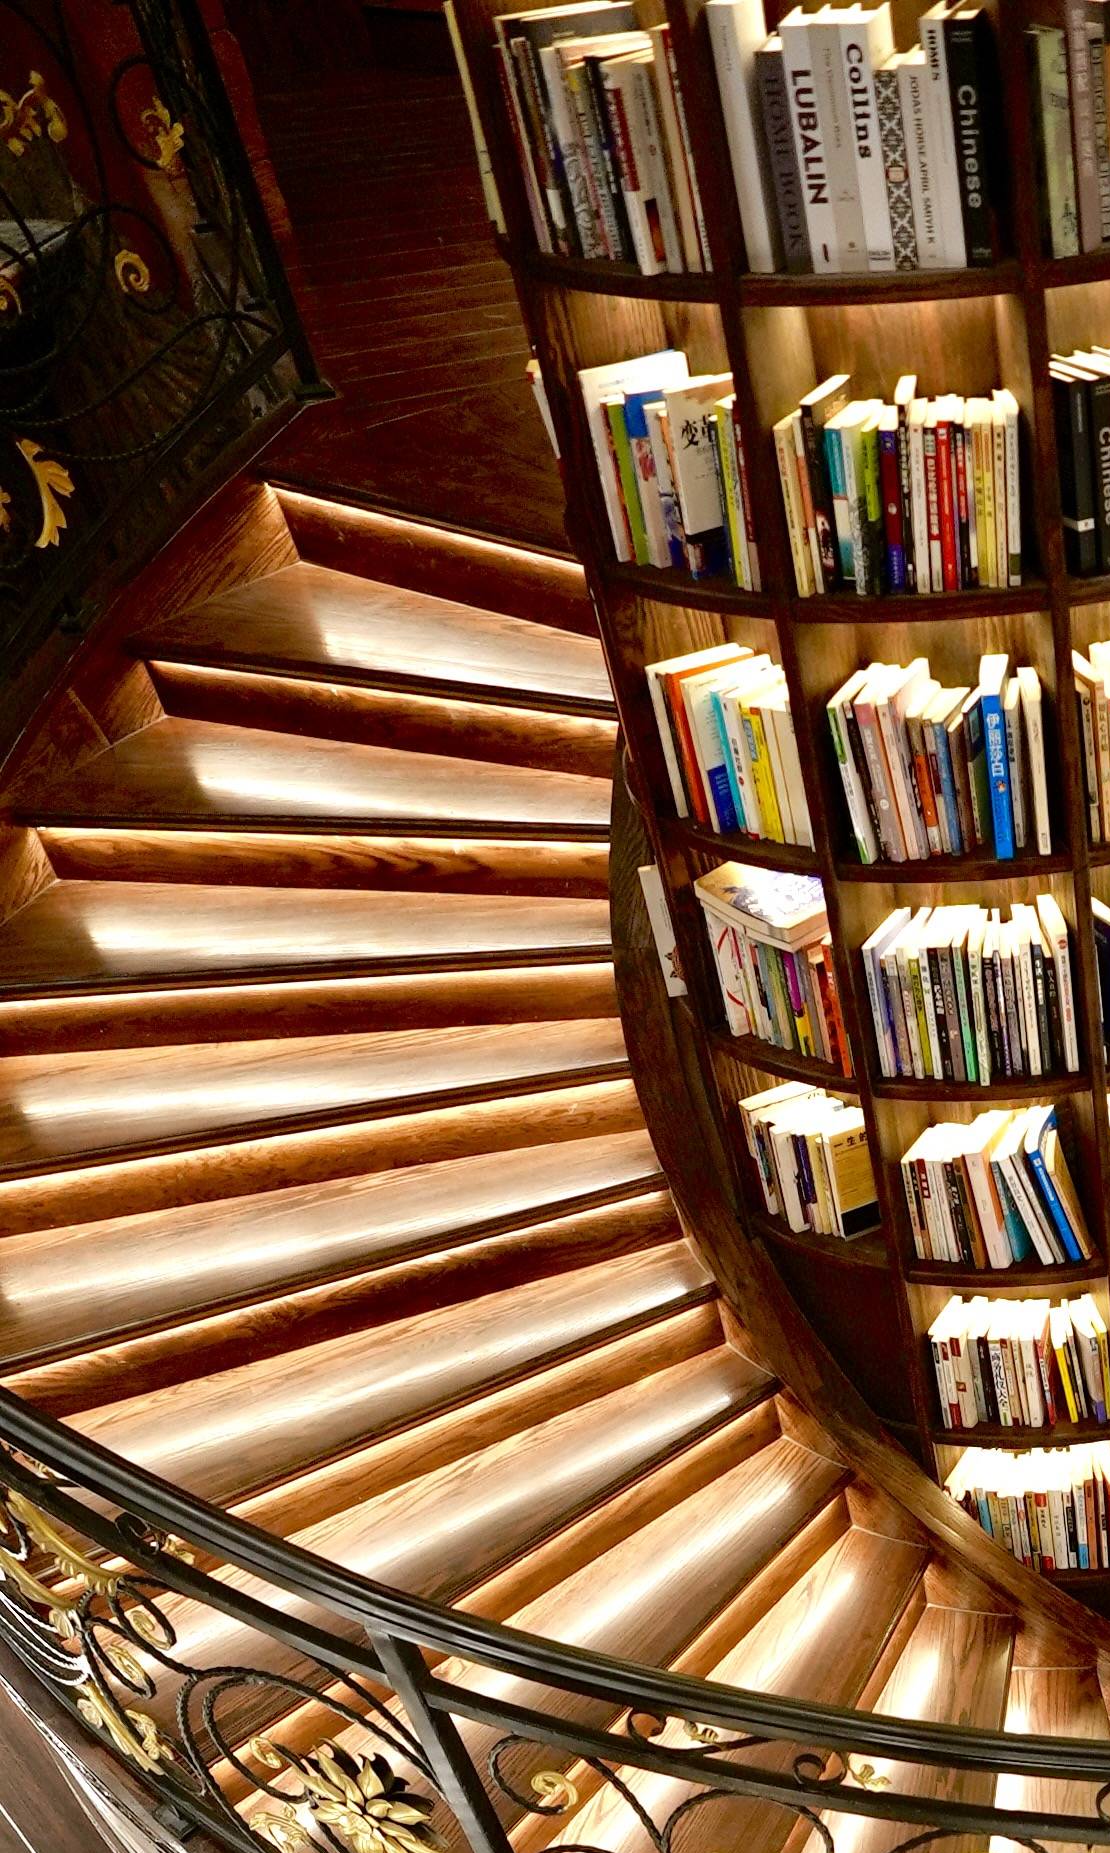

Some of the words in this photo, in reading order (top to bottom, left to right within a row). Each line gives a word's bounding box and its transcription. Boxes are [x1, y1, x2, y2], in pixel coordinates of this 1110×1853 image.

[846, 43, 872, 160] Collins
[926, 29, 940, 82] HOMES
[790, 69, 829, 206] LUBALIN
[957, 85, 982, 209] Chinese
